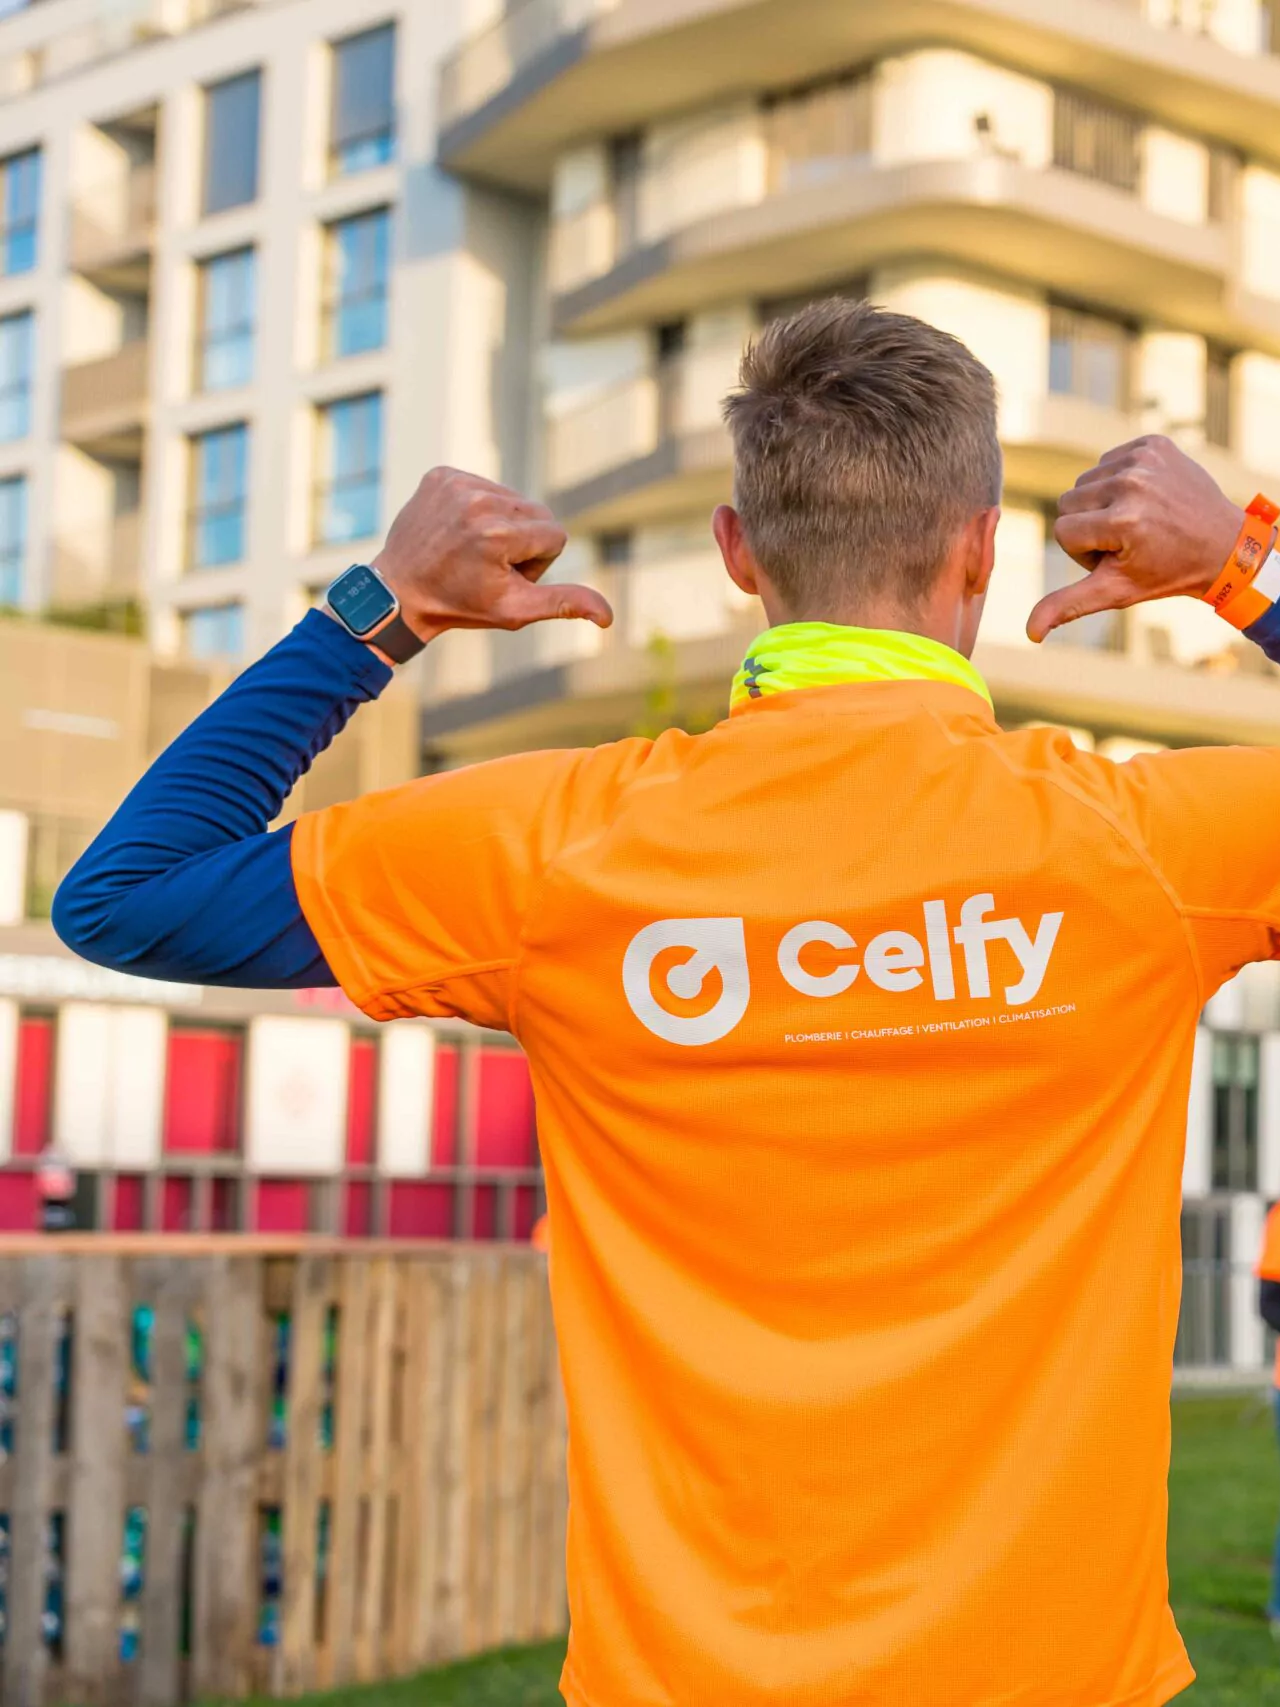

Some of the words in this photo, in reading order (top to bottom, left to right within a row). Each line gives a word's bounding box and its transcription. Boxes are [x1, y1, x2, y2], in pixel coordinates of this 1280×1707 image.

[784, 1031, 843, 1043] PLOMBERIE
[850, 1025, 914, 1040] CHAUFFAGE
[921, 1017, 990, 1034] VENTILATION
[998, 1003, 1077, 1024] CLIMATISATION
